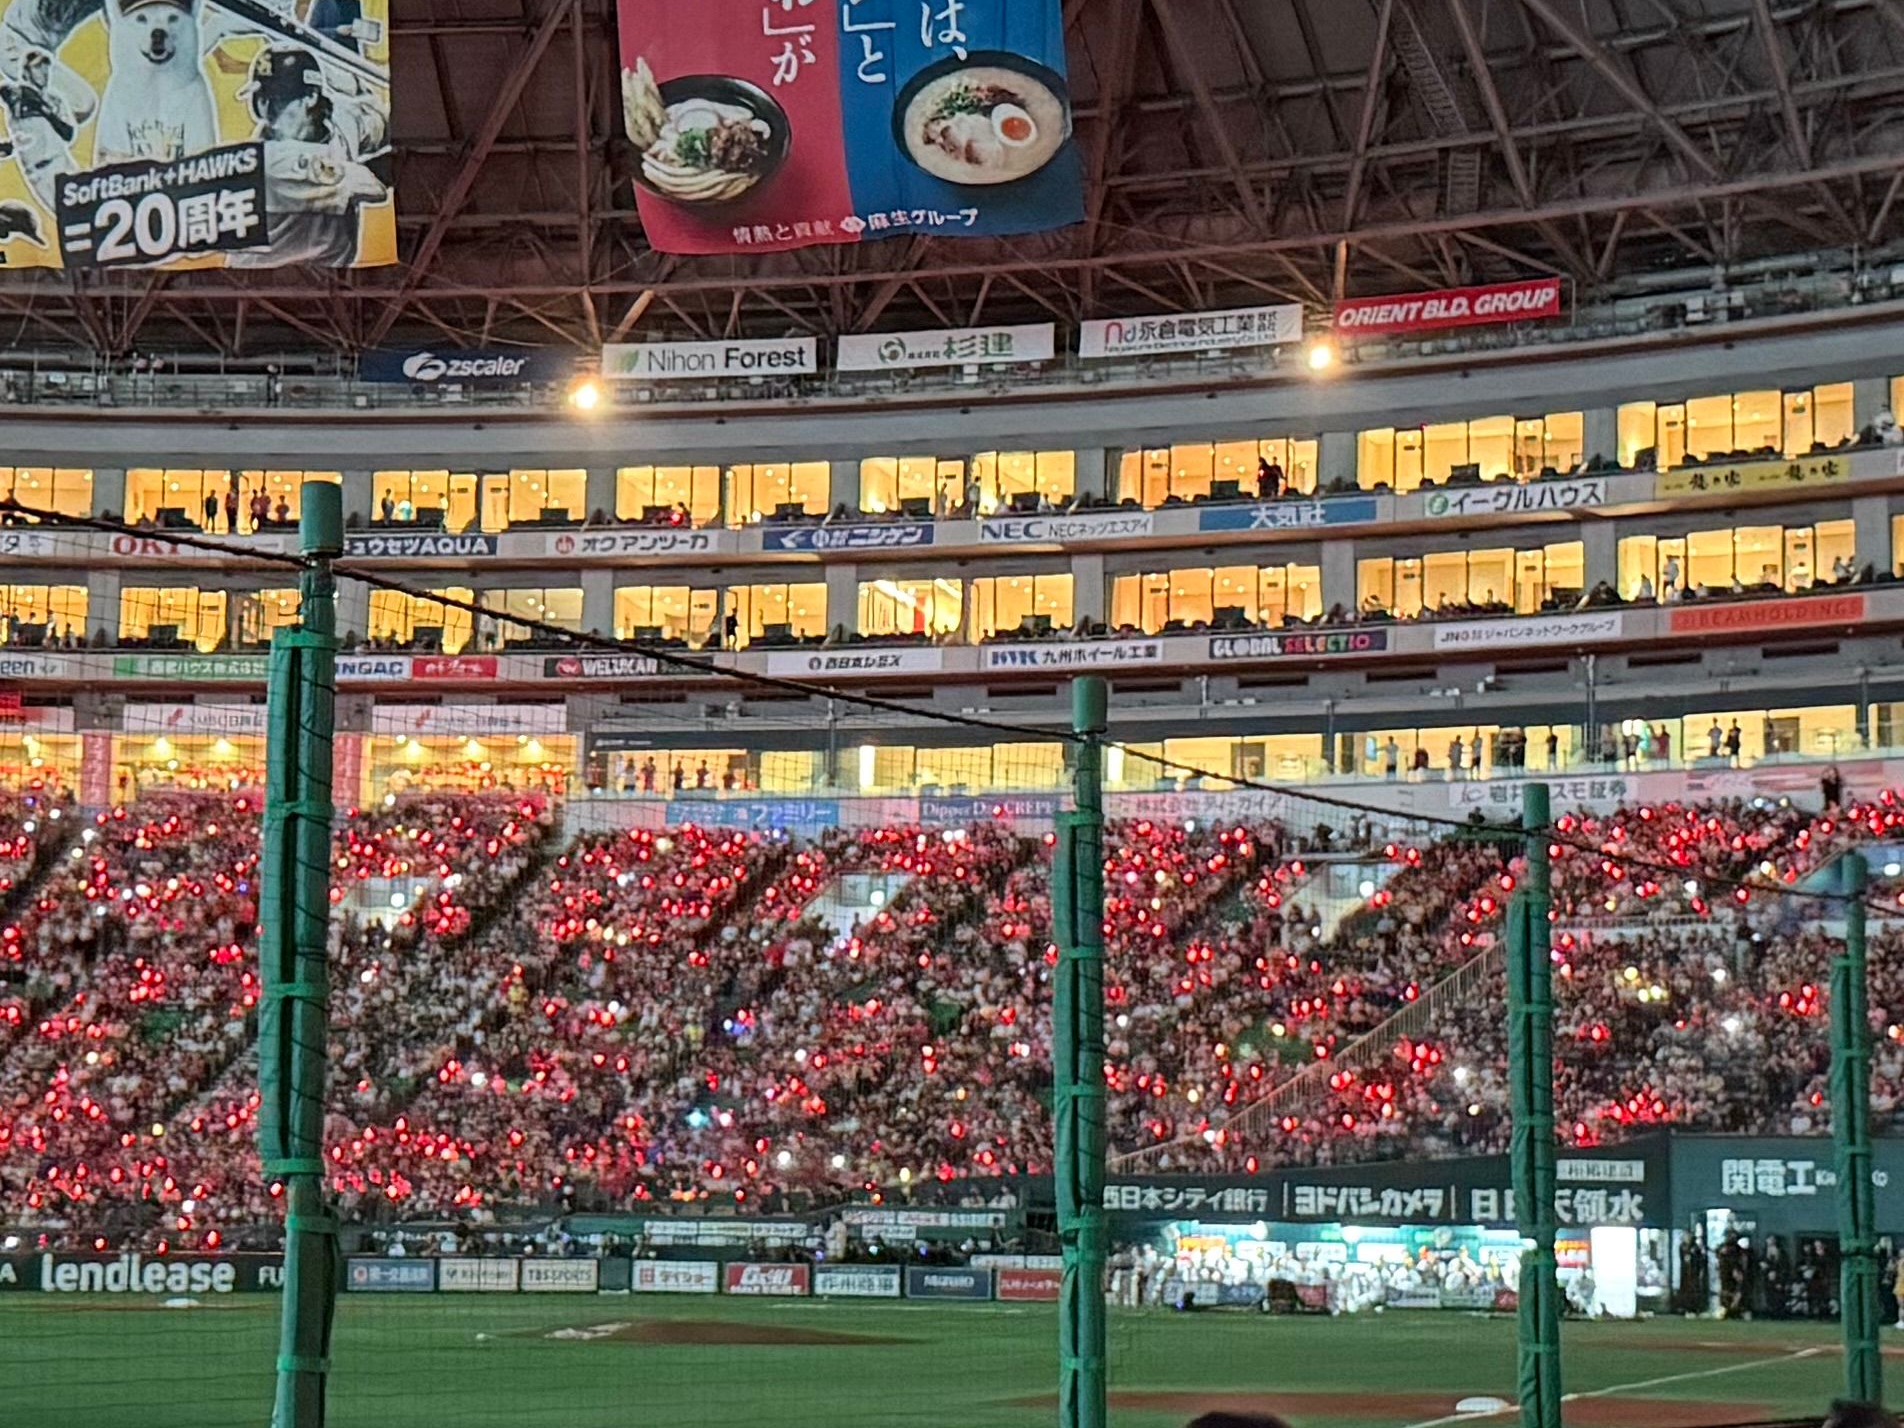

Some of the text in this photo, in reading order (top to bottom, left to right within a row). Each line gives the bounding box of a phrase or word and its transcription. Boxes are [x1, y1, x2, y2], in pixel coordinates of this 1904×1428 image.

[868, 208, 979, 232] 麻生グループ
[1339, 286, 1556, 329] ORIENT BLD. GROUP
[648, 346, 806, 373] Nihon Forest
[942, 332, 1014, 360] 杉建
[446, 356, 526, 377] zscaler
[1450, 481, 1603, 514] イーグルハウス
[980, 514, 1149, 540] NEC NECネッツエスアイ
[1249, 501, 1326, 528] 大気社
[344, 537, 489, 556] ュウセツAQUA
[581, 533, 710, 553] オクアンツーカ
[1042, 644, 1158, 665] 九州ホイール工業
[1213, 634, 1371, 658] GLOBAL SELECTIO
[1722, 1159, 1817, 1196] 関電工
[1102, 1186, 1267, 1213] 西日本シティ銀行
[1294, 1187, 1444, 1217] ヨドバシカメラ
[40, 1252, 238, 1293] lendlease
